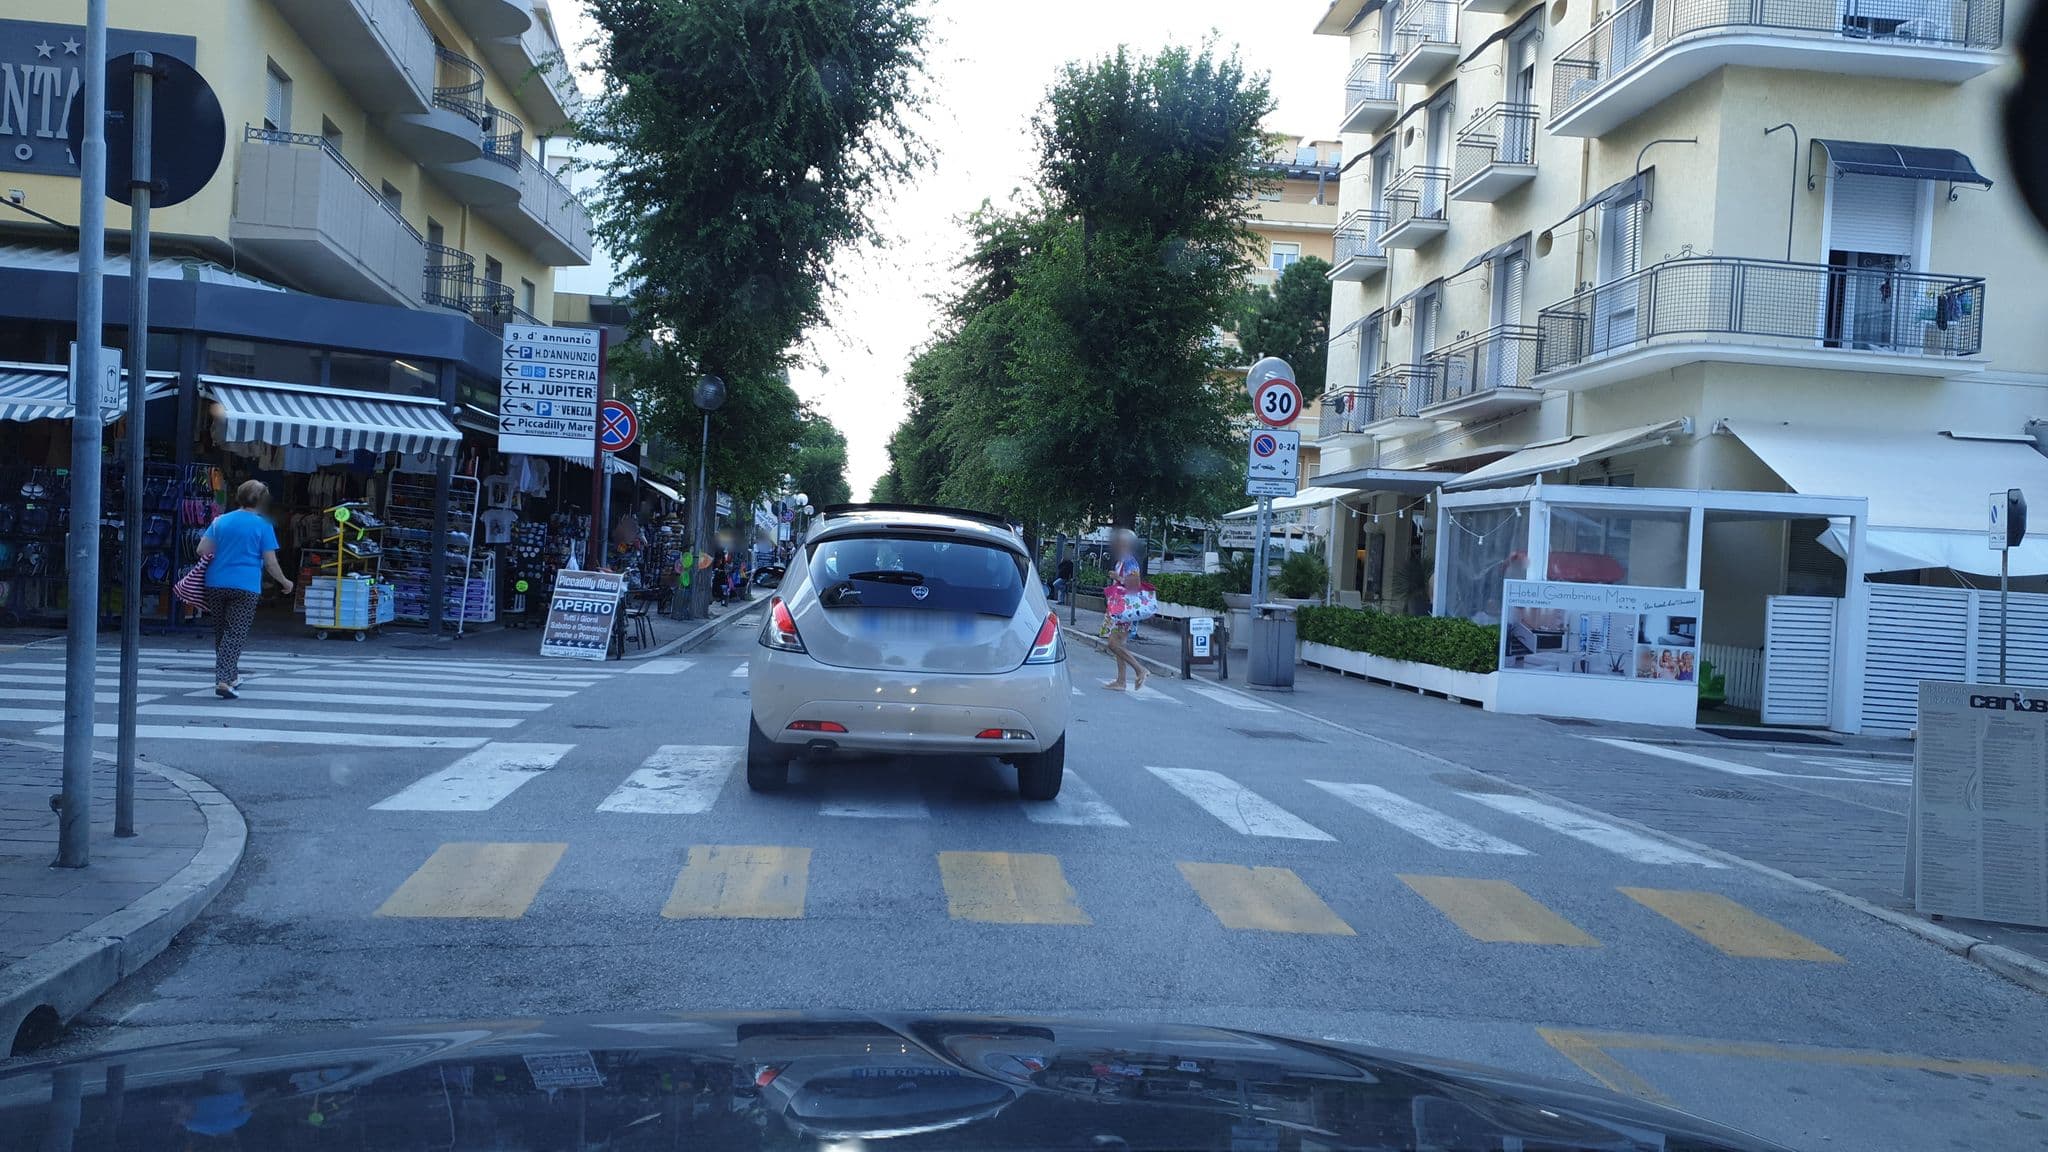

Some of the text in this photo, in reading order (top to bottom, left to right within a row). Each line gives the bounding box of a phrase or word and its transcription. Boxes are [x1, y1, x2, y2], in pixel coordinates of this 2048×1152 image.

[512, 332, 522, 341] g.
[542, 334, 591, 344] annunzio
[548, 368, 597, 381] ESPERIA
[521, 382, 593, 399] H. JUPITER
[103, 396, 117, 404] 0-24
[1265, 391, 1292, 414] 30
[561, 405, 593, 417] VENEZIA
[517, 418, 594, 432] Piccadilly Mare
[1278, 443, 1296, 452] 0-24
[558, 575, 618, 591] Piccadilly Mare
[1509, 584, 1540, 598] Hotel
[1542, 585, 1601, 602] Gambrinus
[1604, 589, 1637, 605] Mare
[554, 600, 611, 614] APERTO
